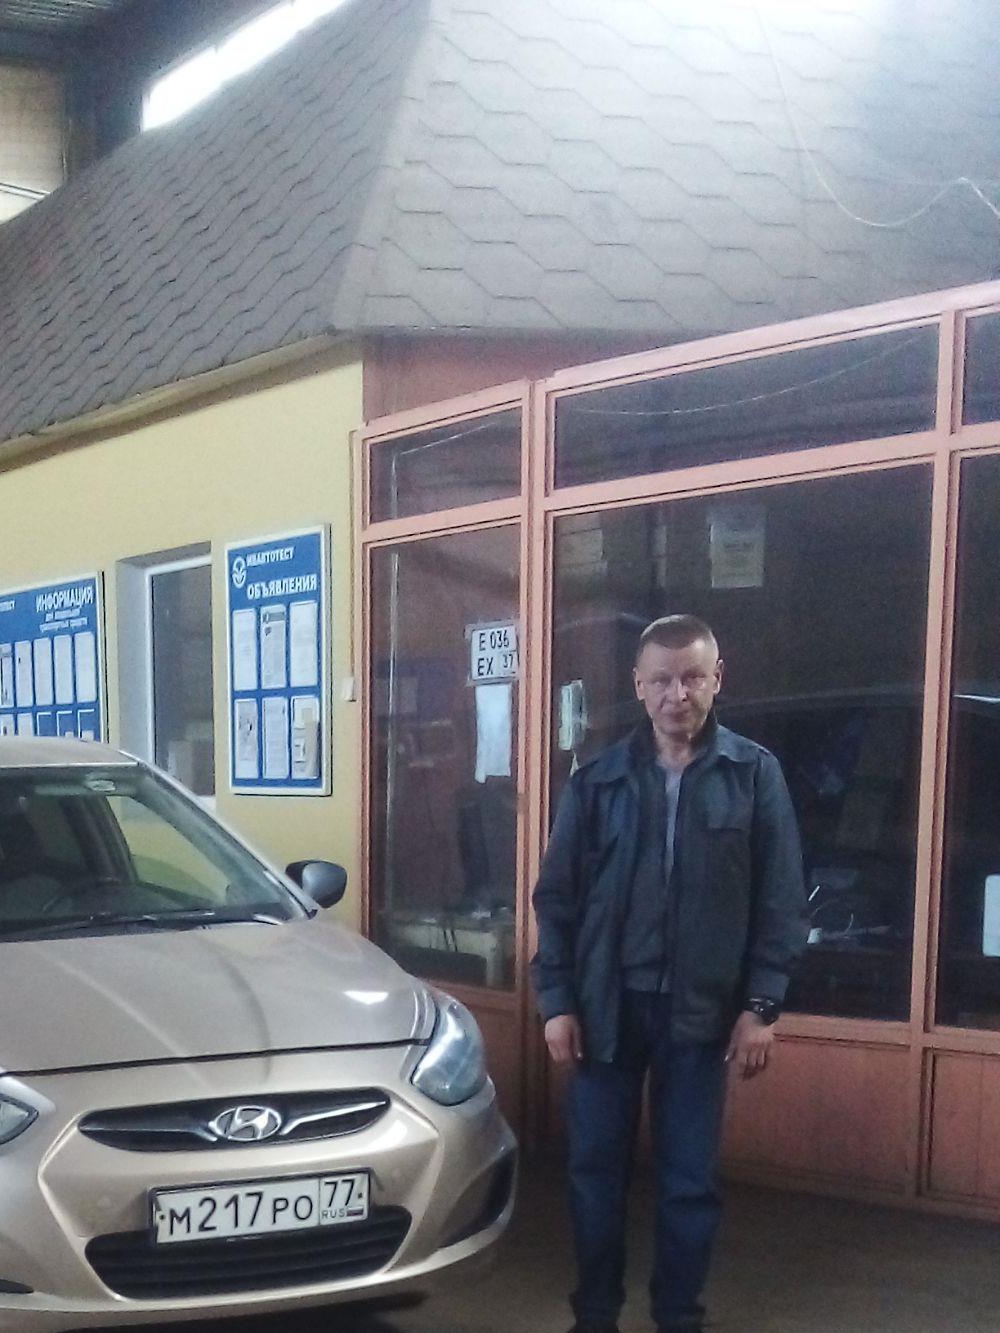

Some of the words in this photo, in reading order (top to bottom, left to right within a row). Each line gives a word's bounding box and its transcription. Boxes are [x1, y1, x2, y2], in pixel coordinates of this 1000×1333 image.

[35, 586, 94, 613] ИНФОРМАЦИЯ
[246, 573, 318, 600] ОБЪЯВЛЕНИЯ
[490, 629, 510, 649] 036
[168, 1191, 314, 1236] М217РО
[324, 1178, 356, 1208] 77
[321, 1207, 346, 1219] RUS
